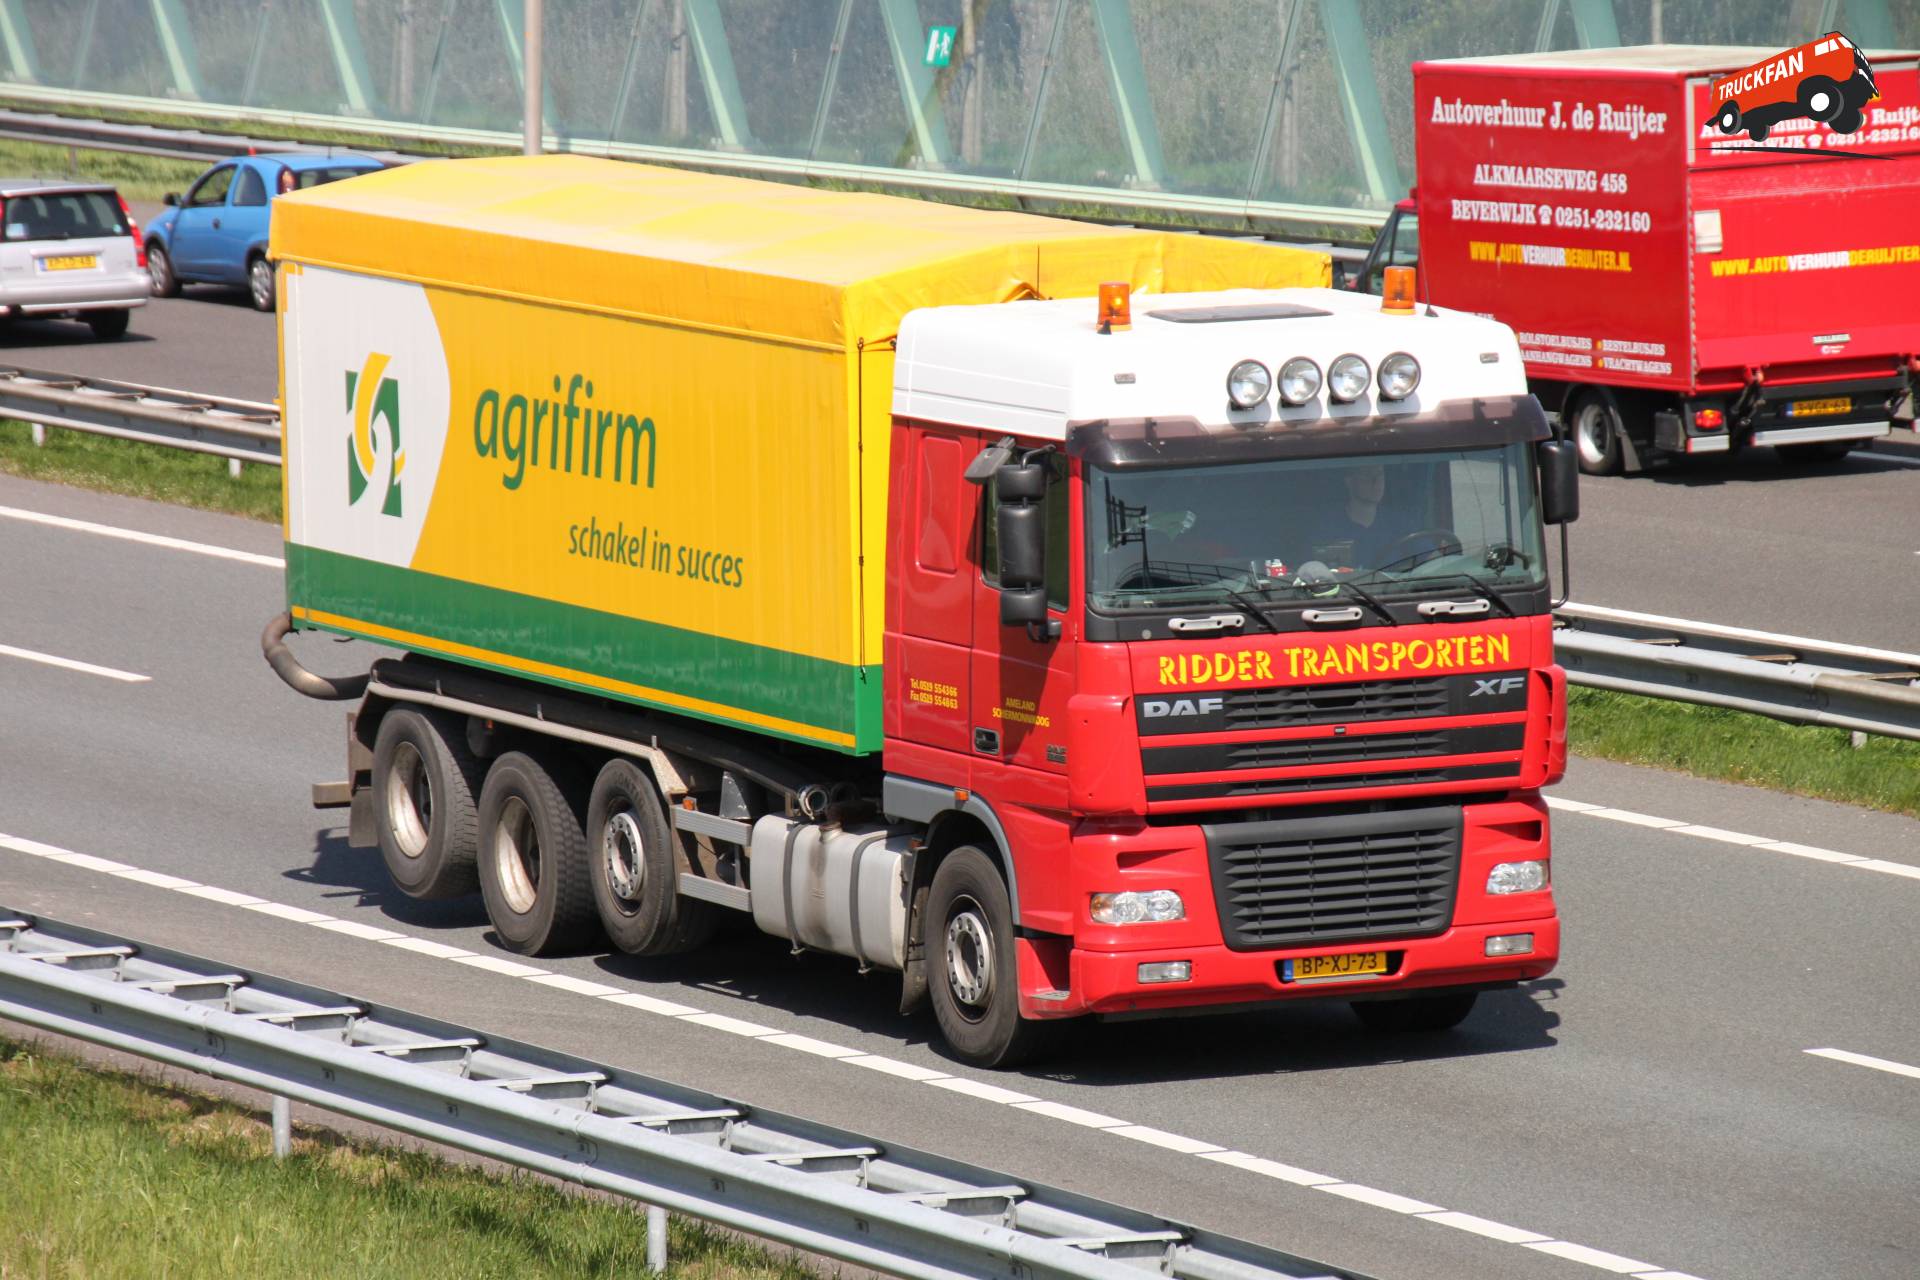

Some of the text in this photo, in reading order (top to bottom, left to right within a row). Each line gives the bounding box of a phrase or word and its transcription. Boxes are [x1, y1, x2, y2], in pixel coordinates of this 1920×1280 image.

[1431, 96, 1667, 140] Autoverhuur J. de Ruijter
[1871, 106, 1920, 127] Ruijt
[1826, 126, 1920, 147] 0251-23216
[1473, 164, 1628, 193] ALKMAARSEWEG 458
[1451, 199, 1651, 233] BEVERWIJK 0251-232160
[474, 373, 657, 490] agrifirm
[568, 516, 744, 588] schakel in succes
[1159, 634, 1510, 686] RIDDER TRANSPORTEN
[1468, 677, 1526, 697] XF
[1143, 698, 1224, 718] DAF
[1302, 953, 1377, 975] BP-XJ-73
